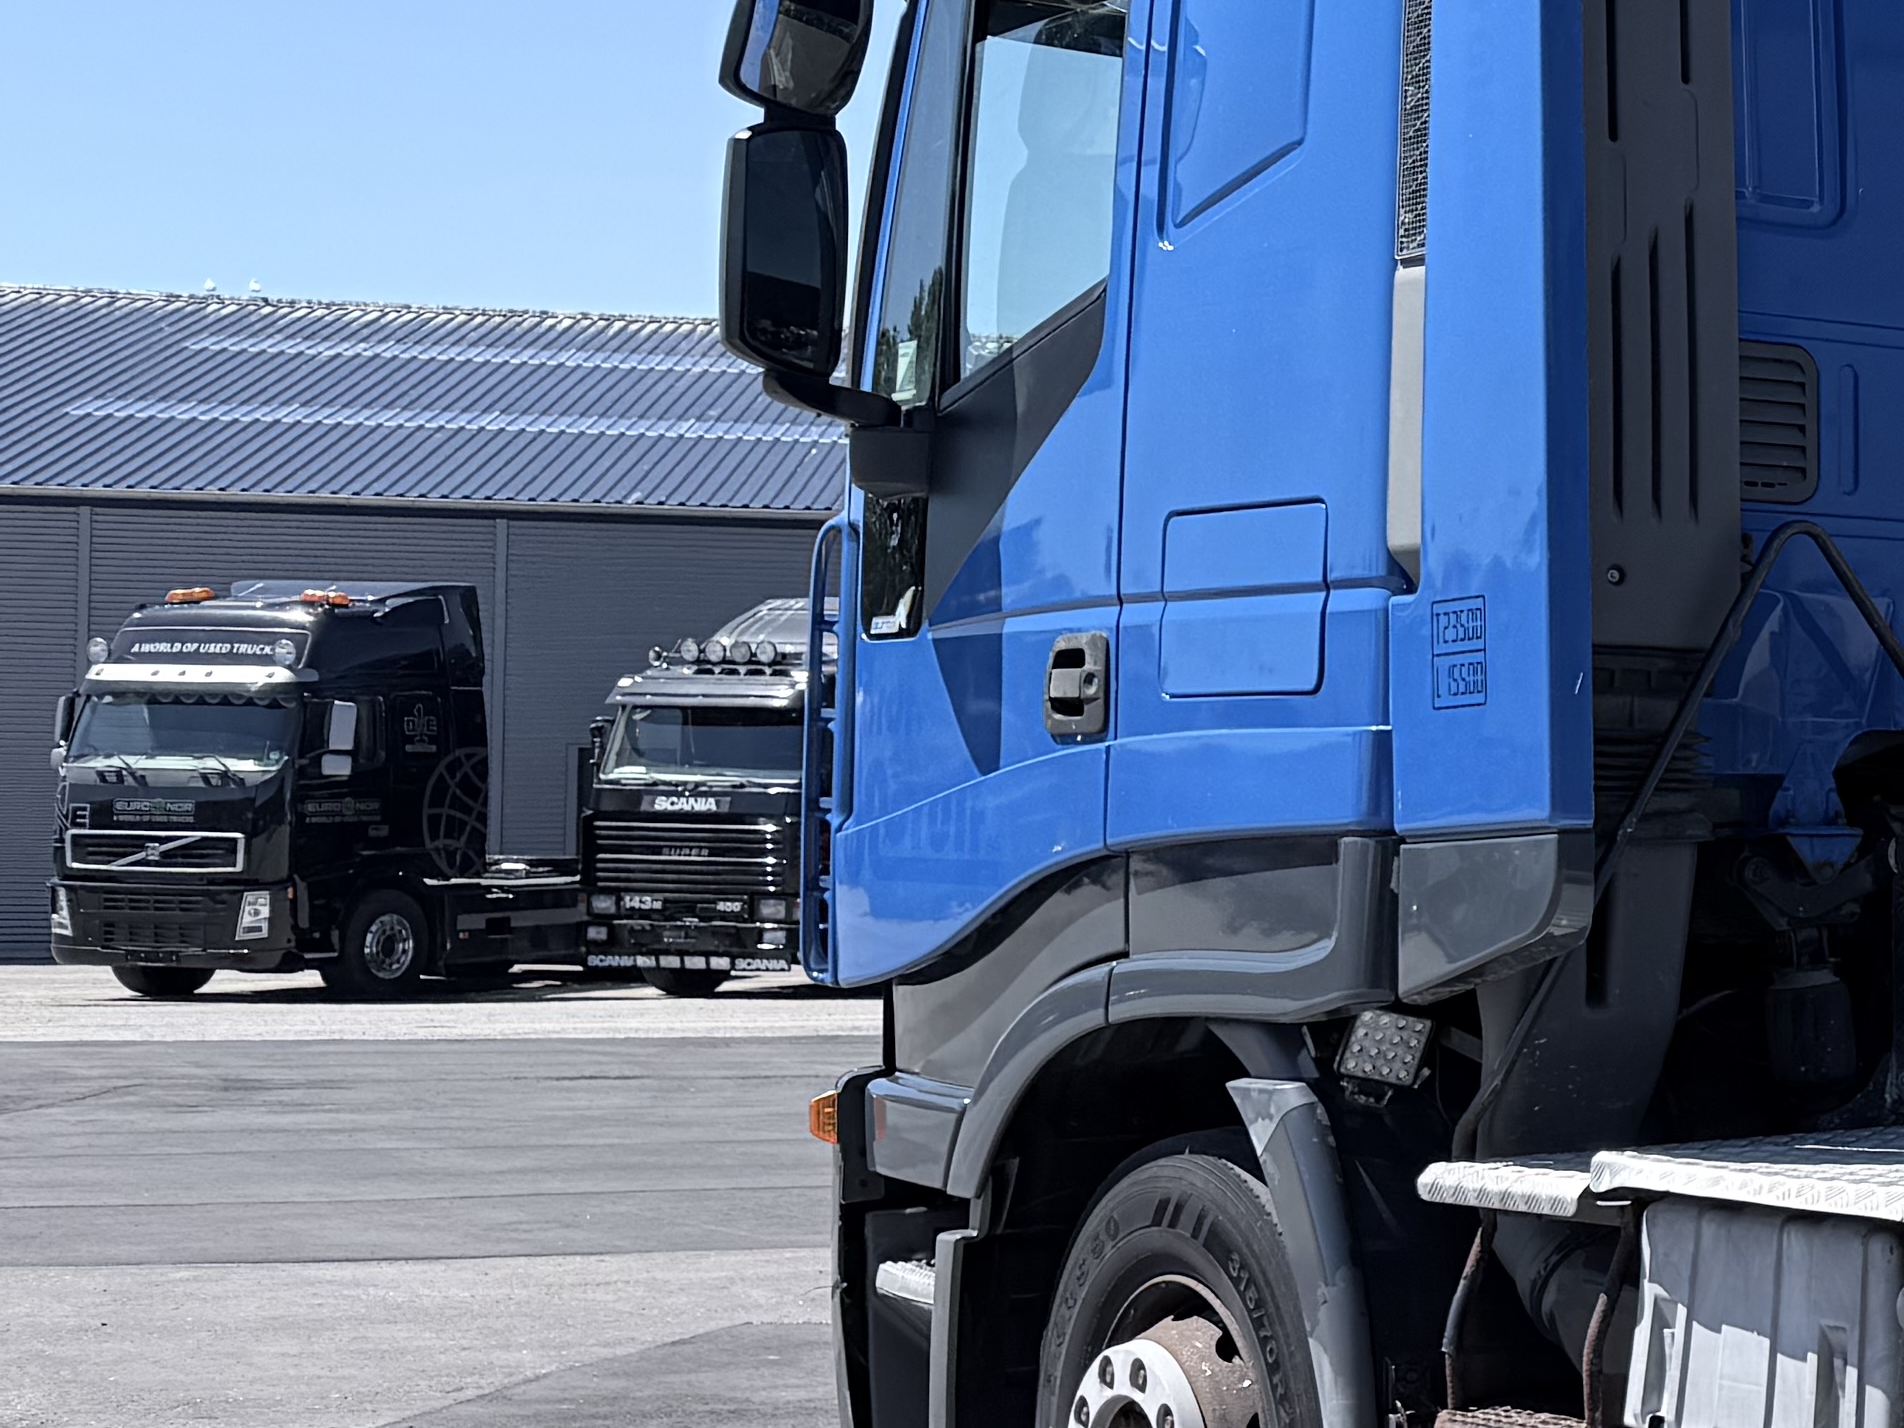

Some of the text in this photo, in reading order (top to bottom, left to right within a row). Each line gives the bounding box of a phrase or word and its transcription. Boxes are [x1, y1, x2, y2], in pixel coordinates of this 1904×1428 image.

[140, 643, 181, 653] WORLD
[182, 643, 199, 652] OF
[199, 643, 231, 653] USED
[232, 644, 273, 655] TRUCK
[654, 797, 717, 810] SCANIA
[735, 959, 789, 970] SCANIA
